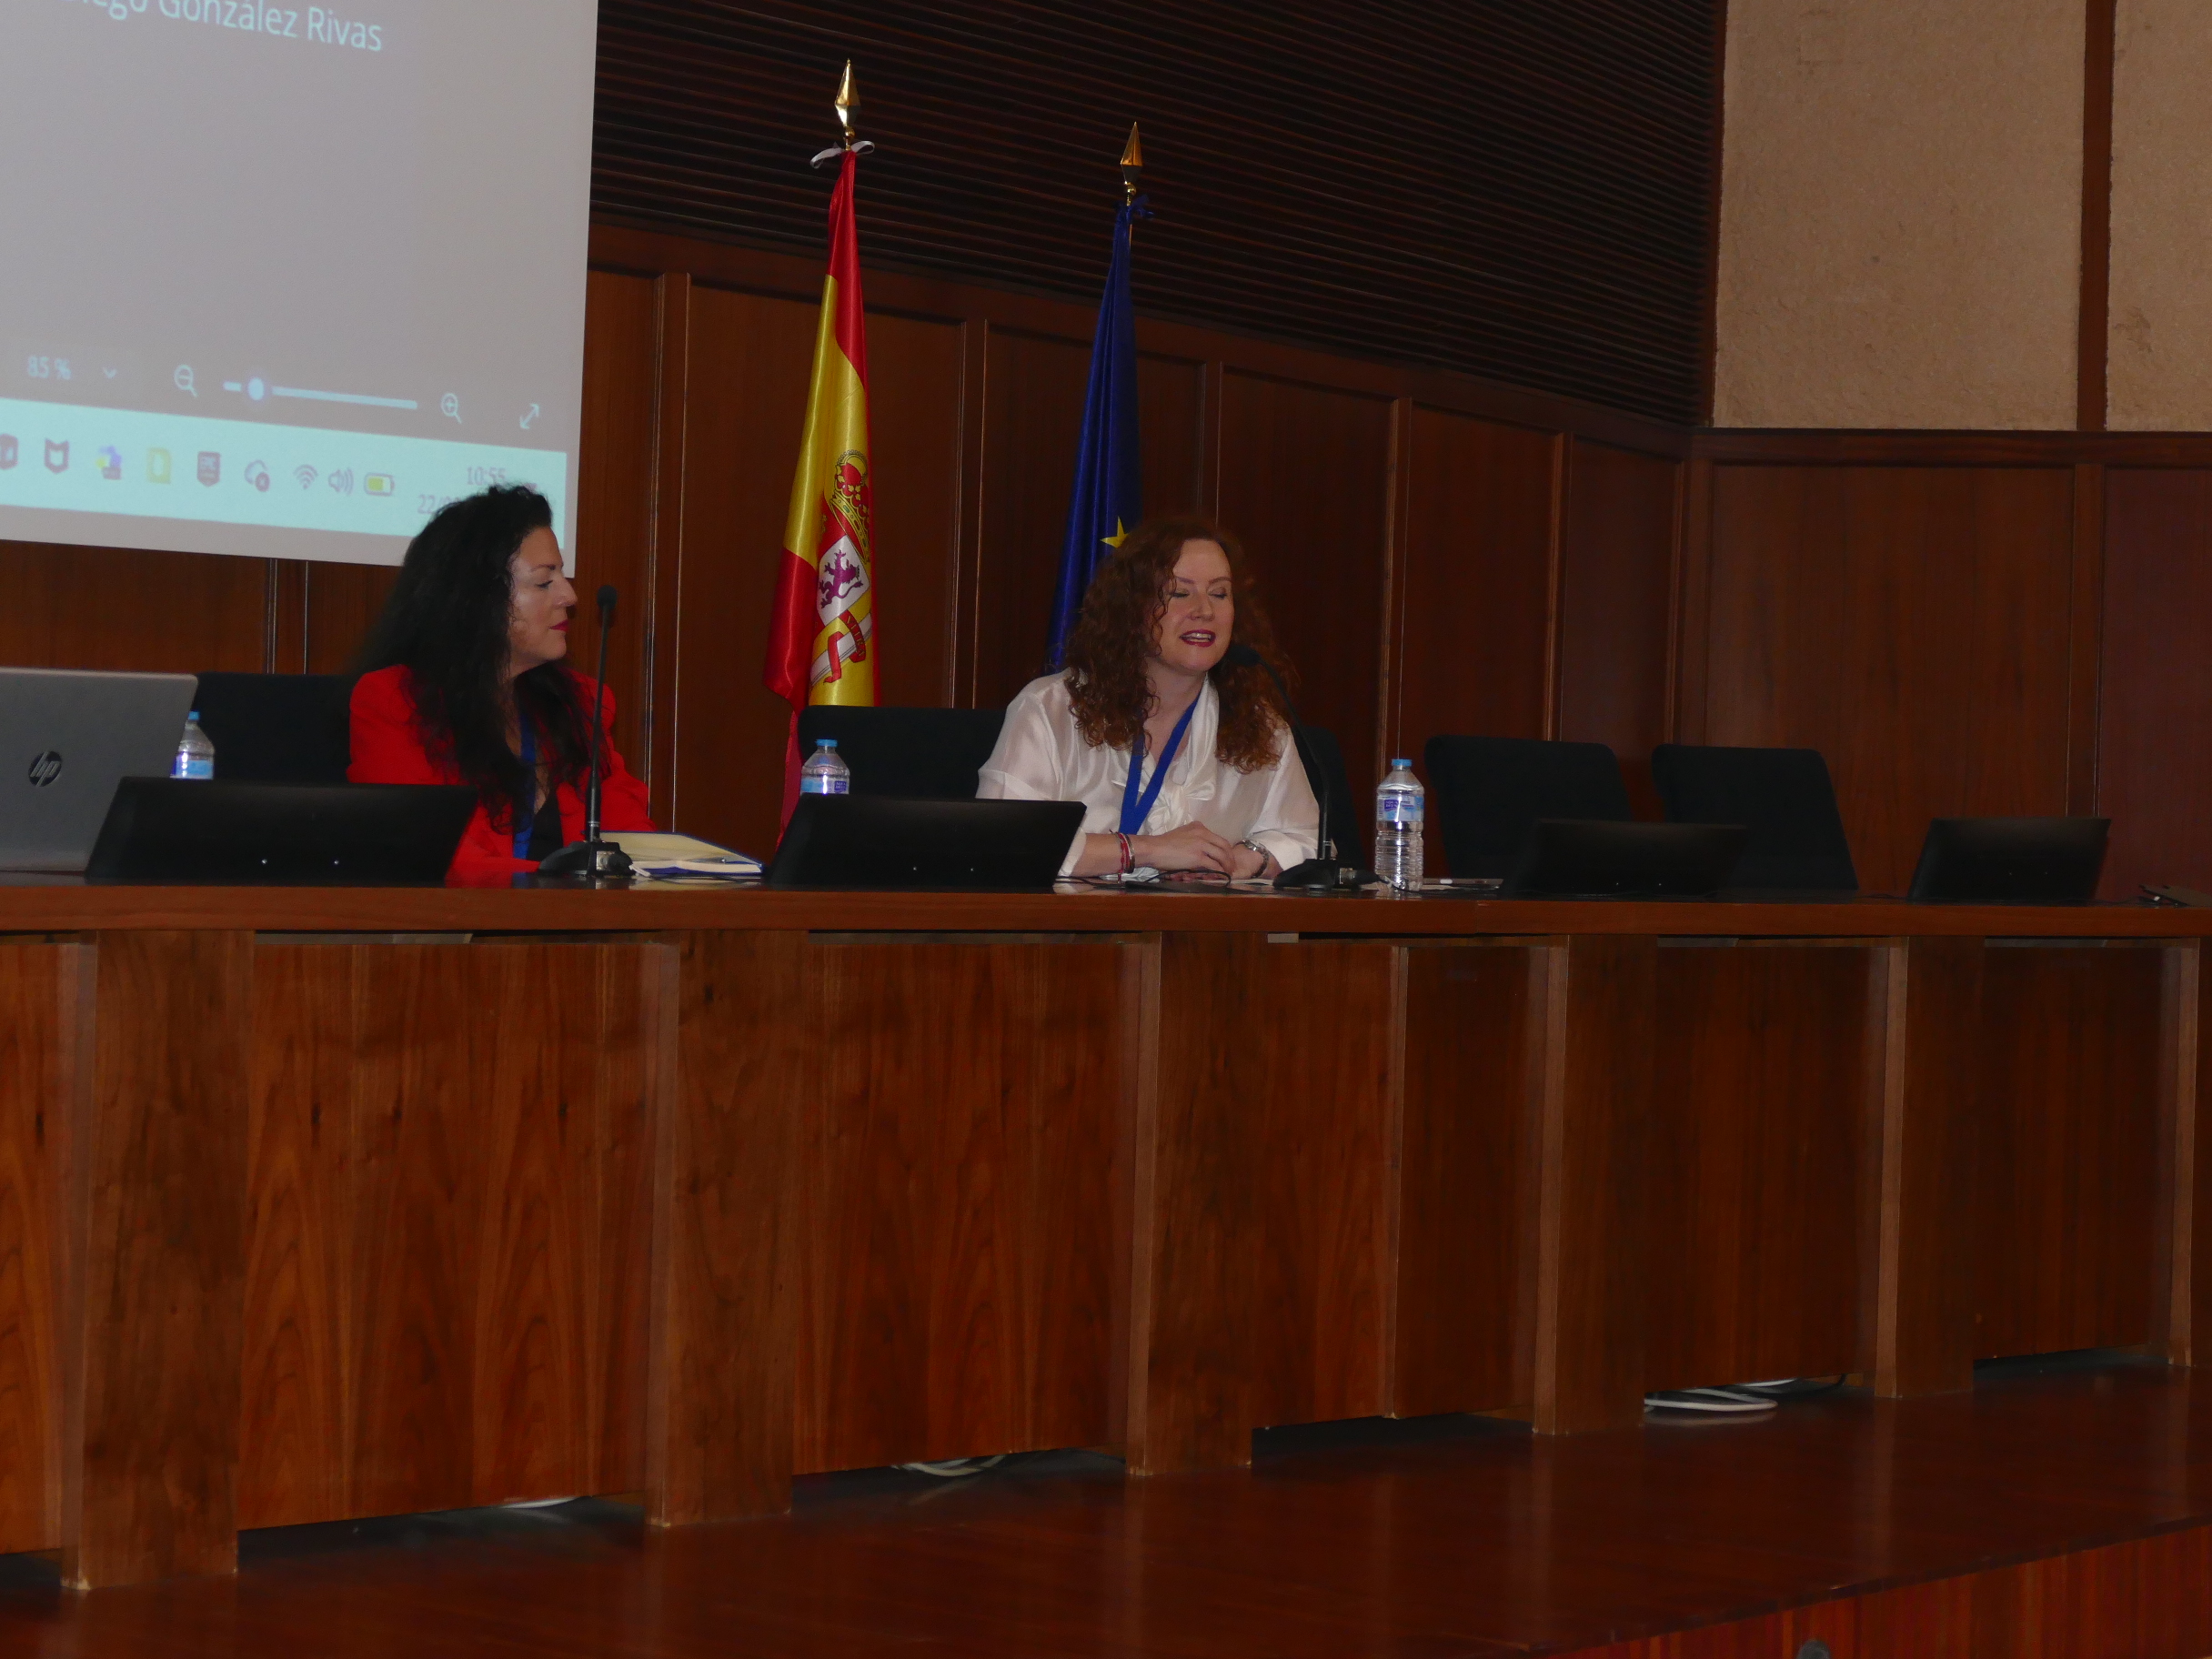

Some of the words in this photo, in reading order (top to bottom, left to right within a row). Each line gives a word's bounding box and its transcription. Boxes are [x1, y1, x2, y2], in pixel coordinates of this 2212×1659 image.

[158, 0, 298, 38] González
[307, 6, 382, 52] Rivas
[26, 355, 49, 378] 85
[29, 751, 62, 787] hp
